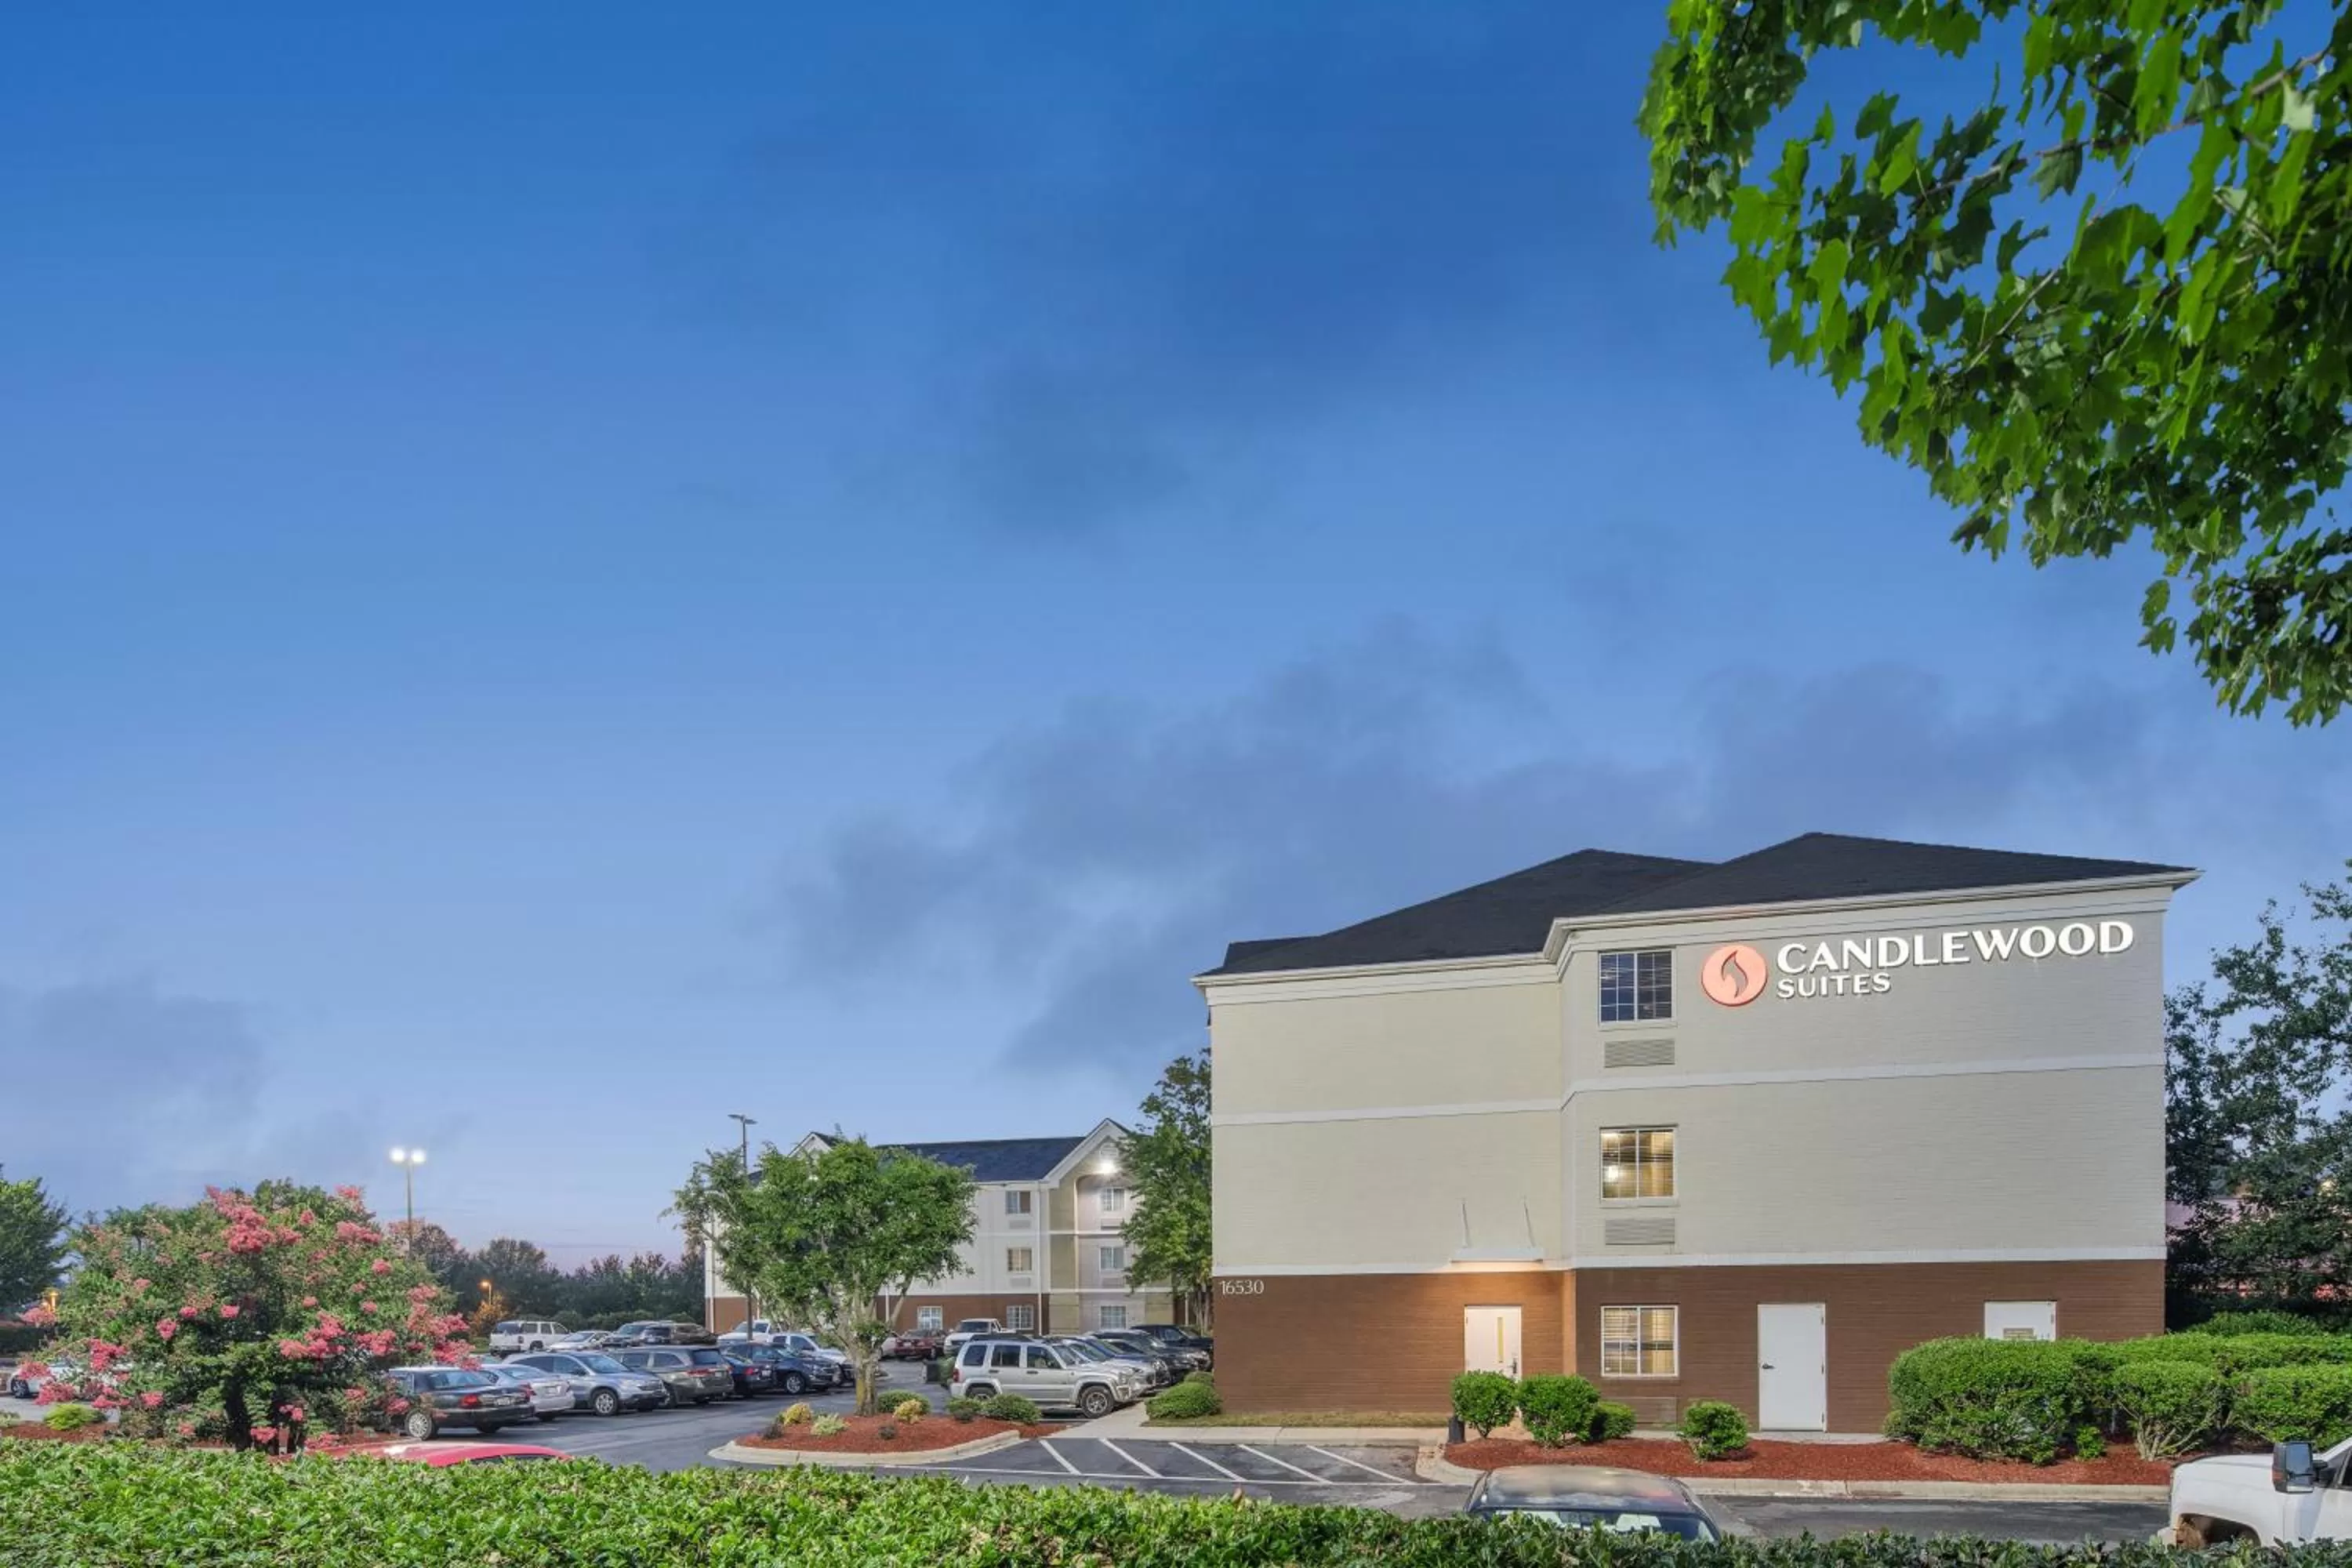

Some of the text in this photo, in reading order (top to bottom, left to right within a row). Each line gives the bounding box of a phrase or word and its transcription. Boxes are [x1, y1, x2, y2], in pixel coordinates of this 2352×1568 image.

[1777, 921, 2134, 974] CANDLEWOOD
[1777, 972, 1891, 998] SUITES
[1220, 1279, 1265, 1294] 16530
